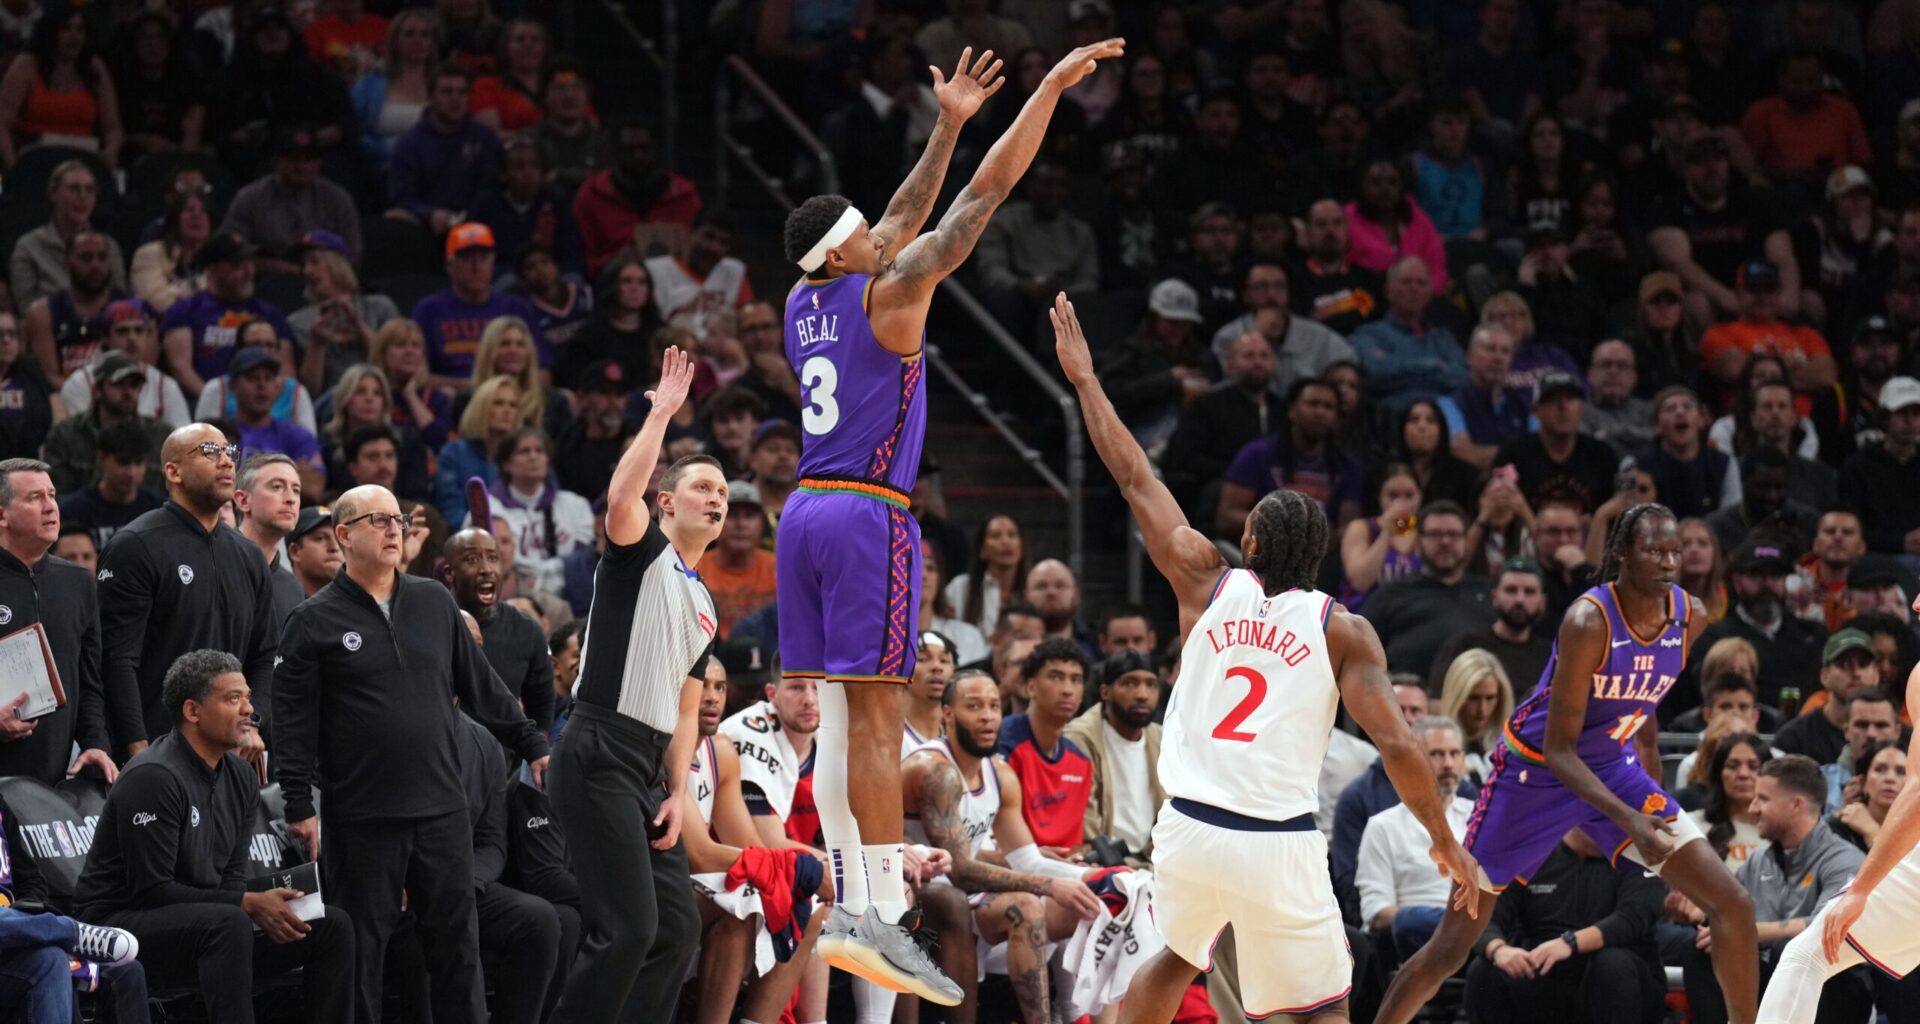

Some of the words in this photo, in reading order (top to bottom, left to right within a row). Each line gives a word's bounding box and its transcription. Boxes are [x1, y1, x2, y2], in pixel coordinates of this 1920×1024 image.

[796, 314, 838, 347] BEAL
[801, 356, 839, 436] 3
[1206, 619, 1311, 667] LEONARD
[1660, 637, 1682, 648] PayPal
[1633, 655, 1655, 671] THE
[1211, 666, 1268, 743] 2
[1610, 714, 1648, 740] 11
[132, 811, 158, 827] Clips
[526, 816, 550, 829] Clips
